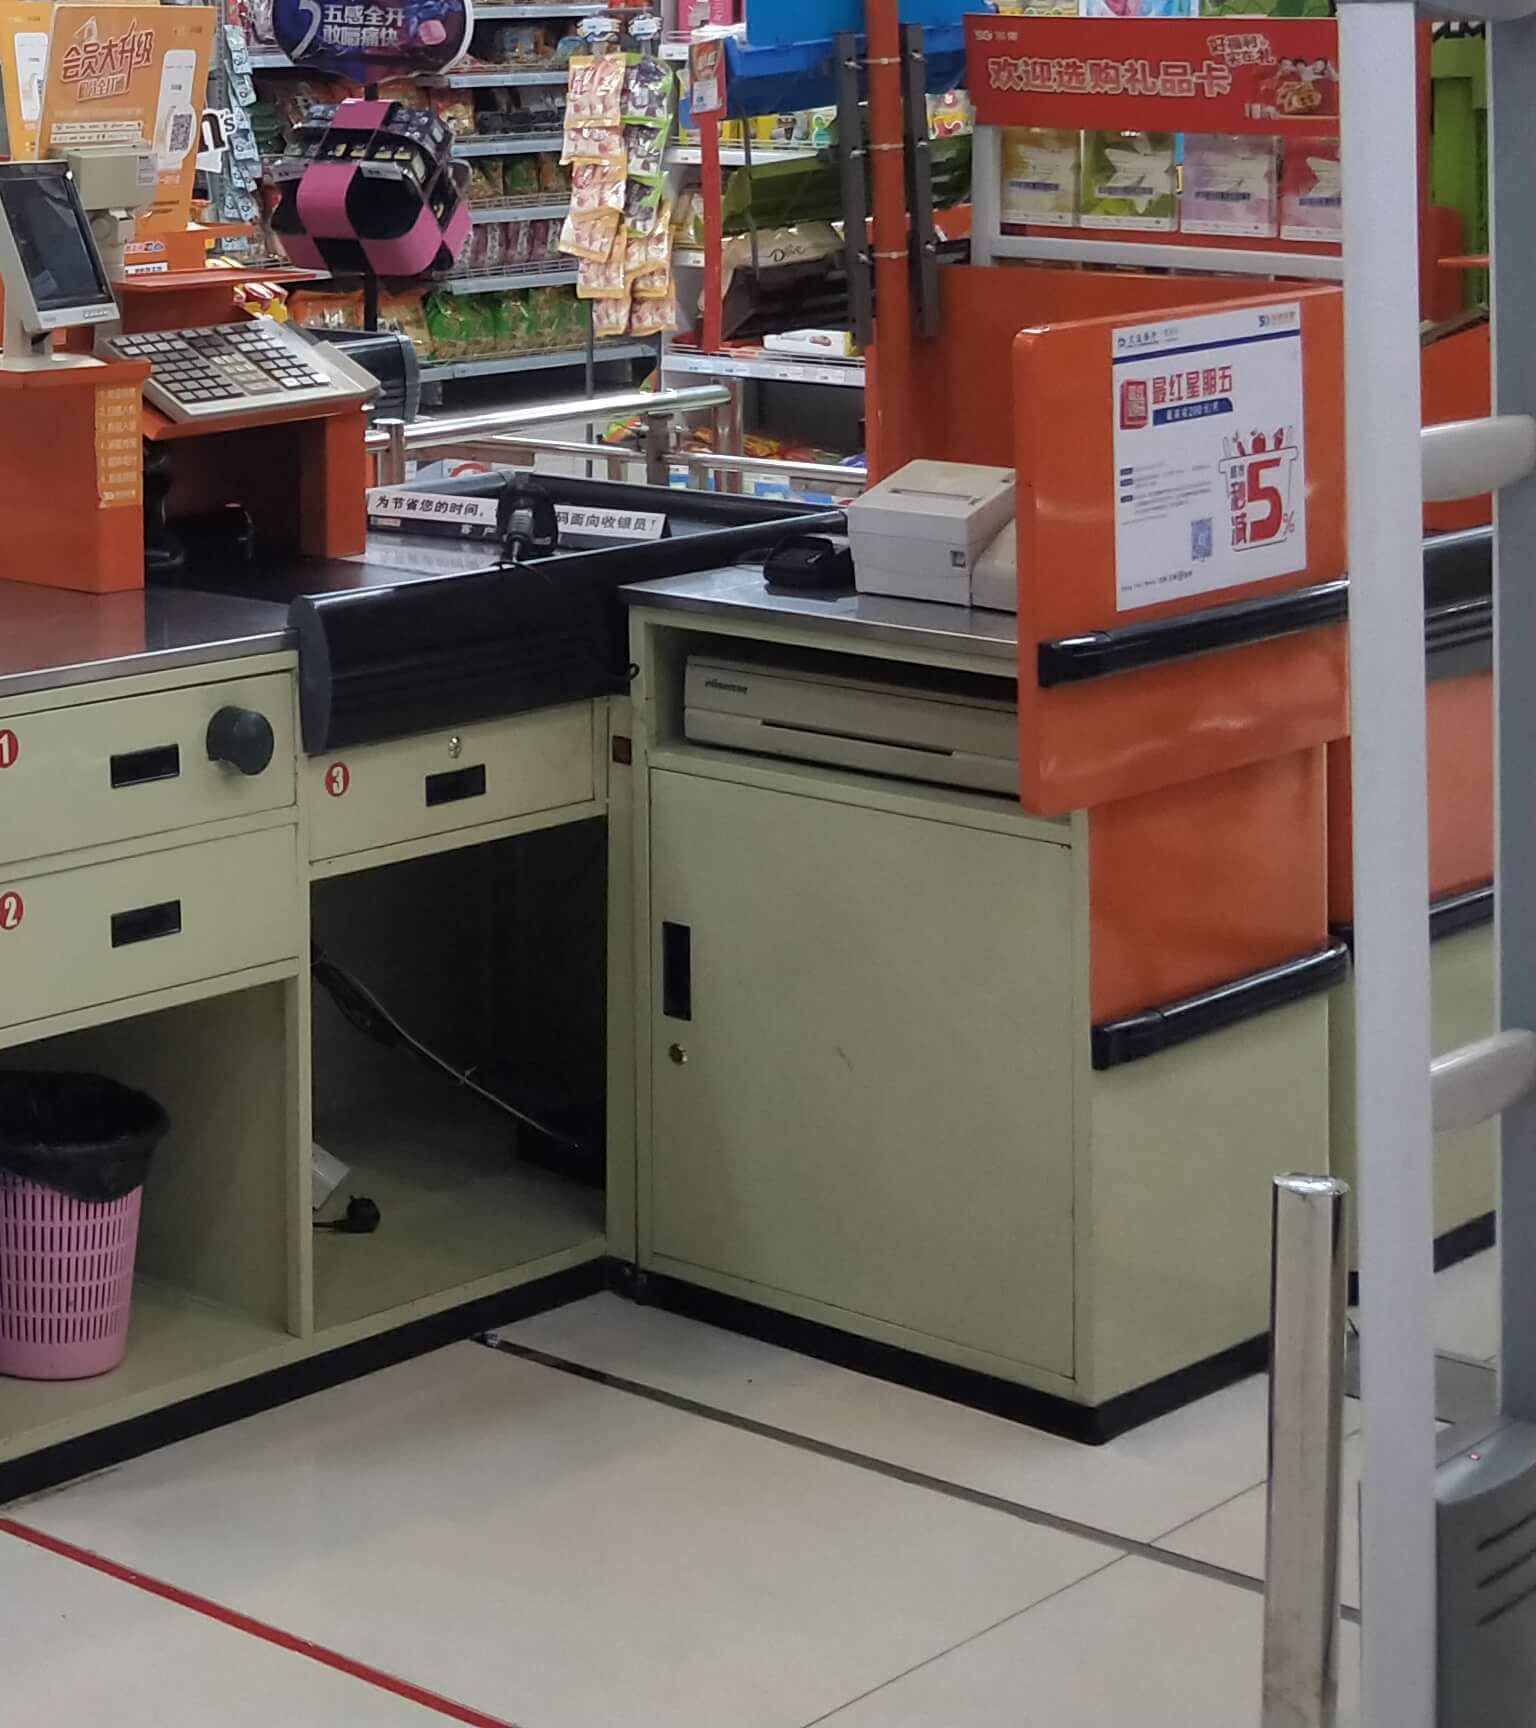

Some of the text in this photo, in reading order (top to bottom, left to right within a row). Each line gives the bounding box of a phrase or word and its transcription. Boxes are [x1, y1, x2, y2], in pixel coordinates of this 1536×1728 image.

[324, 6, 405, 25] 五感全开
[62, 24, 154, 82] 会员大升级
[988, 57, 1233, 97] 欢迎选购礼品卡
[1152, 365, 1233, 404] 最红星期五
[1247, 457, 1283, 543] 5
